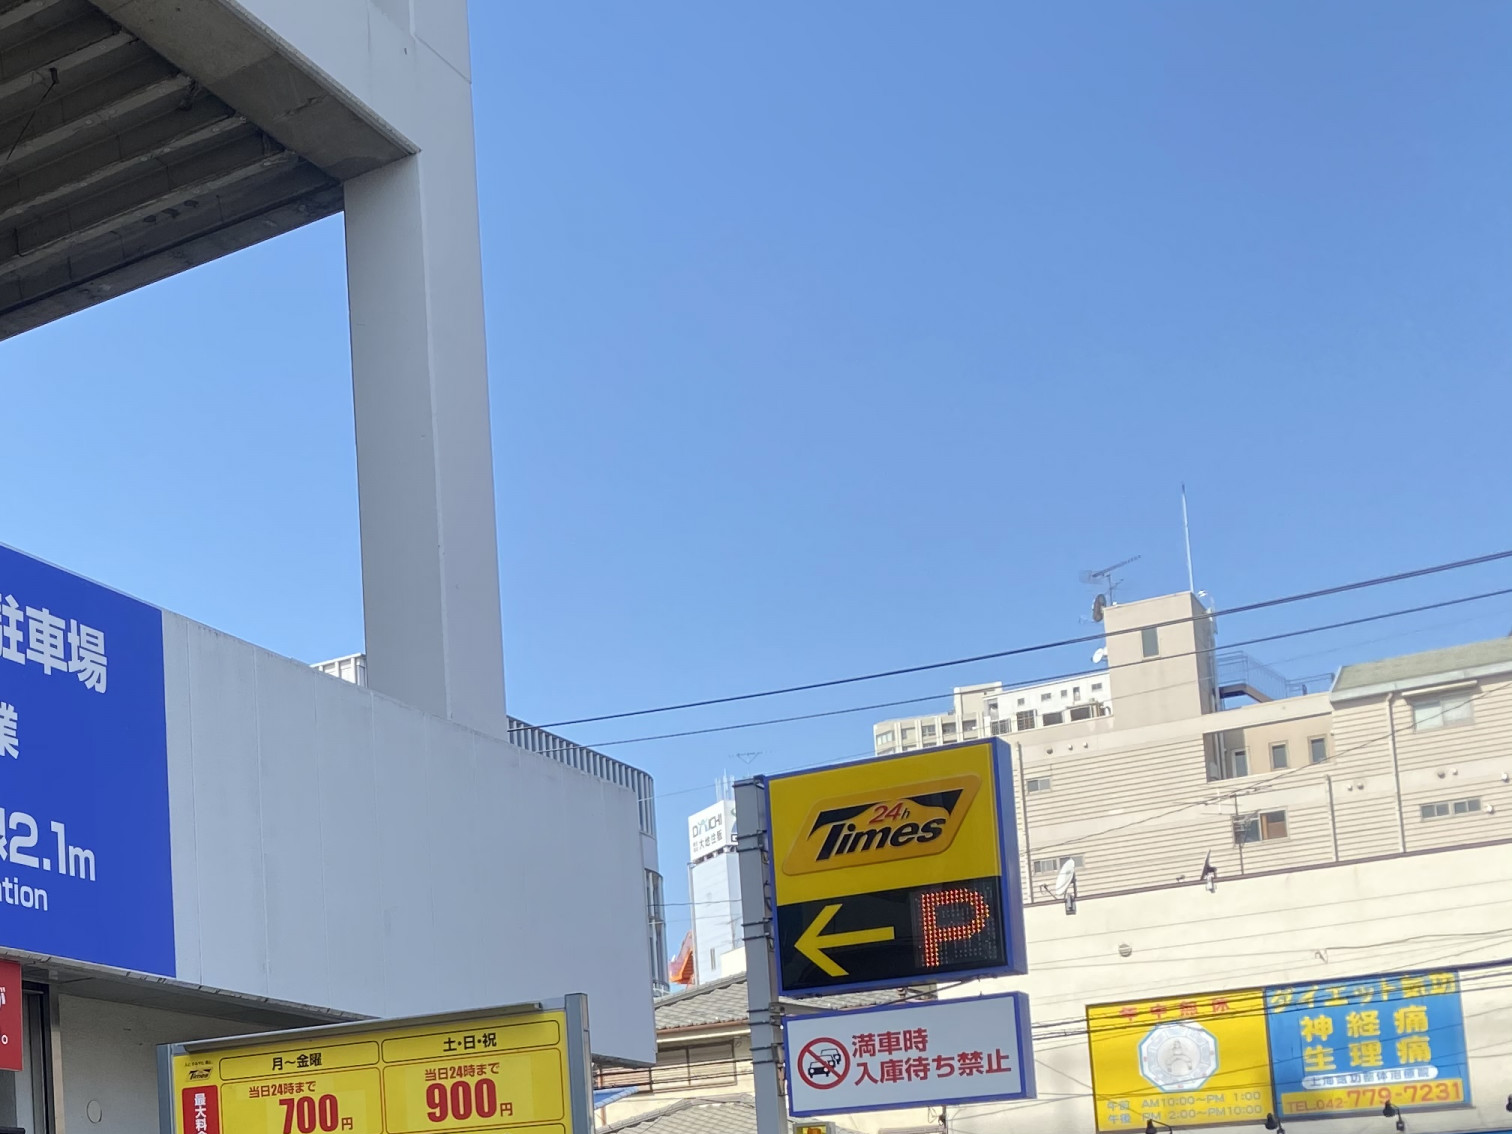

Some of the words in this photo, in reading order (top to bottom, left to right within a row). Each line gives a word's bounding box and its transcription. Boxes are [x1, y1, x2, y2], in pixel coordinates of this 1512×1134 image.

[868, 801, 910, 825] 24h
[808, 811, 946, 862] Times
[921, 888, 990, 968] P
[1119, 998, 1229, 1022] 年中無休
[1300, 1005, 1428, 1042] 神経痛
[852, 1028, 928, 1057] 満車時
[1303, 1036, 1431, 1072] 生理痛
[272, 1053, 322, 1071] 月～金曜
[425, 1062, 500, 1082] 当日24時まで
[854, 1049, 1012, 1087] 入庫待ち禁止
[249, 1081, 316, 1098] 当日24時まで
[426, 1078, 513, 1123] 900円
[279, 1094, 353, 1134] 700円
[1108, 1113, 1131, 1124] 午後
